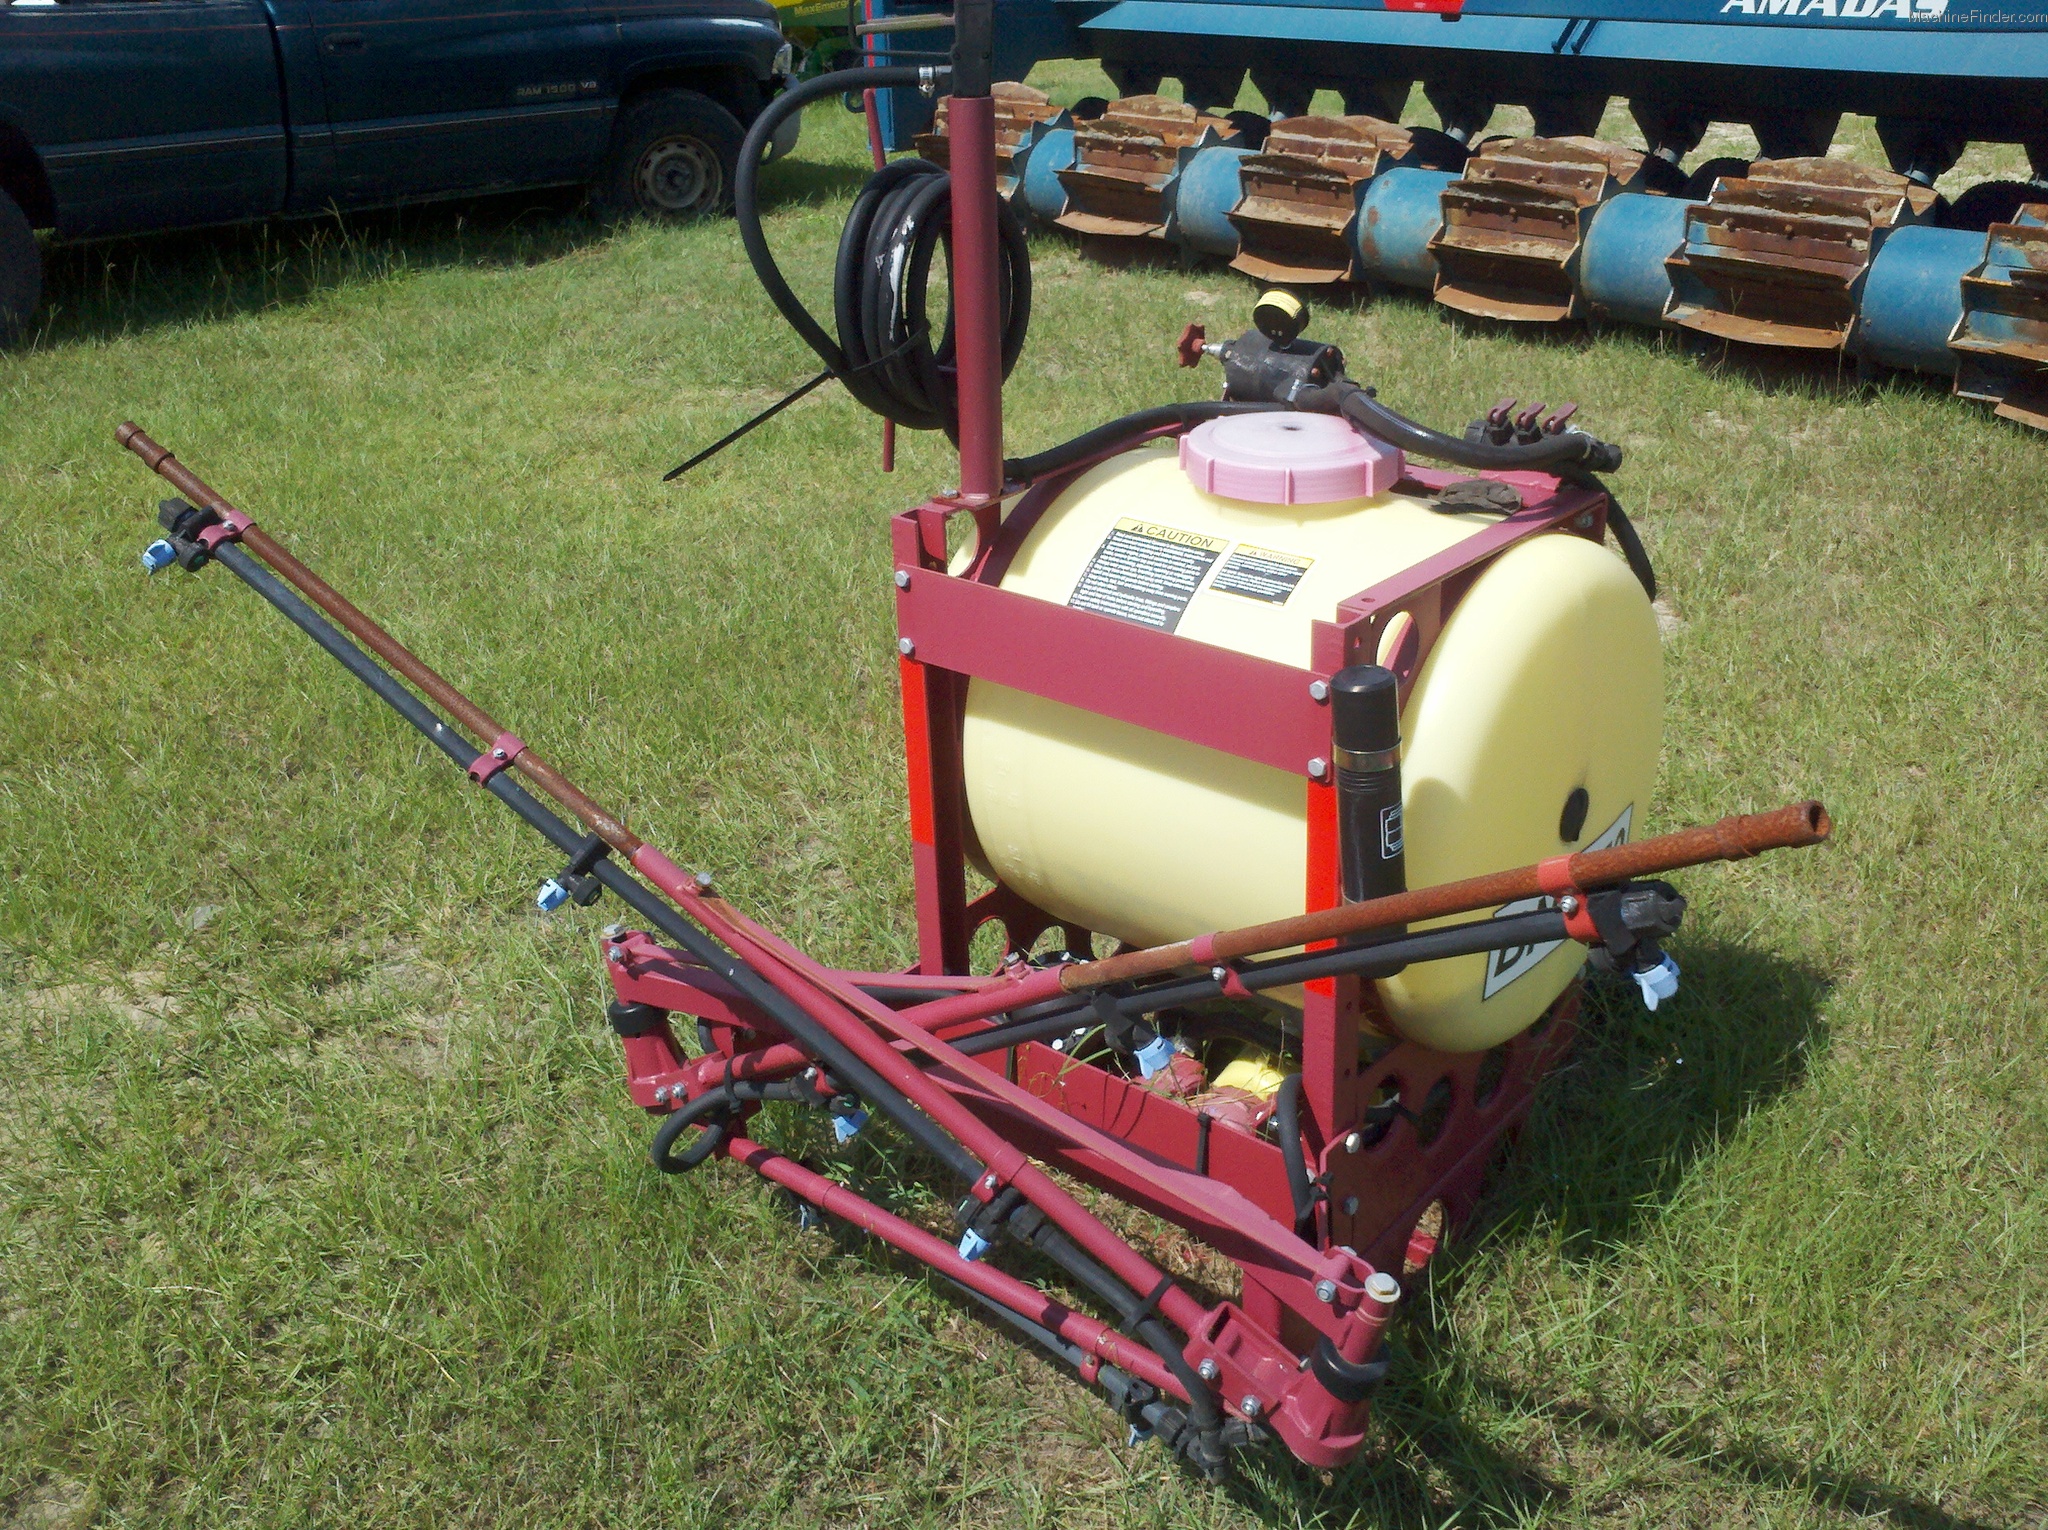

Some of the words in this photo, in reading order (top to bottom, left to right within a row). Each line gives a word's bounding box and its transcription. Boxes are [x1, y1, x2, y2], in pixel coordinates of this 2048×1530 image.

[517, 86, 542, 96] RAM
[1146, 526, 1214, 549] CAUTION
[1259, 550, 1301, 566] WARNING
